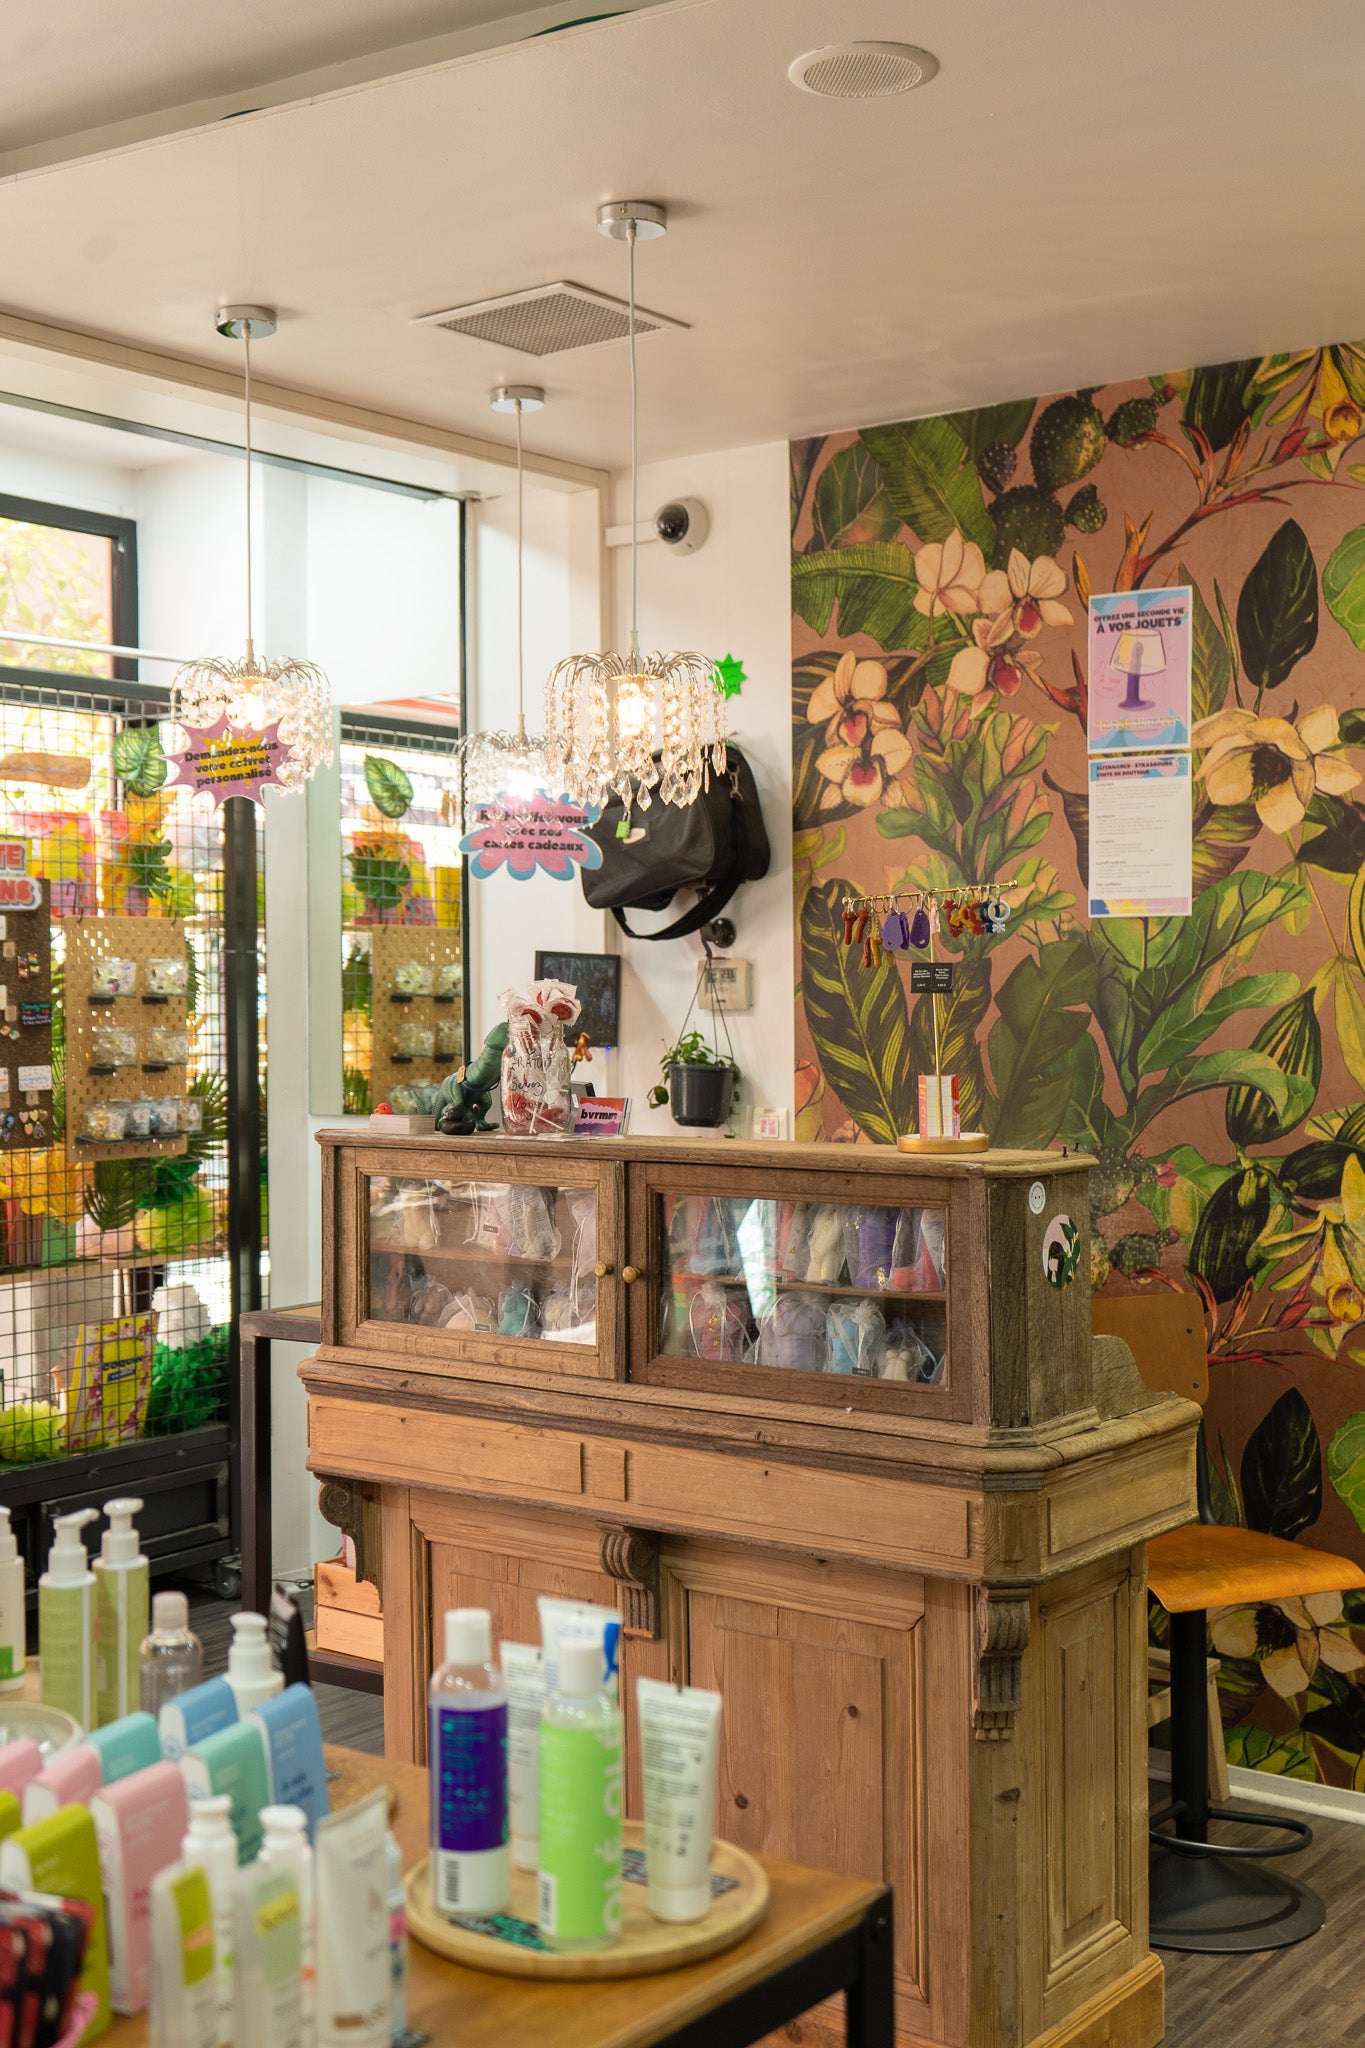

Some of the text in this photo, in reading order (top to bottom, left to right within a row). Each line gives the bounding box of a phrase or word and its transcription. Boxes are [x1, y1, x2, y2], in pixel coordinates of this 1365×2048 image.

[1094, 614, 1120, 622] OFFREZ
[1137, 608, 1171, 617] SECONDE
[1109, 621, 1131, 632] VOS
[1135, 616, 1181, 629] JOUETS
[196, 766, 272, 788] personnalisé
[528, 840, 584, 852] cadeaux
